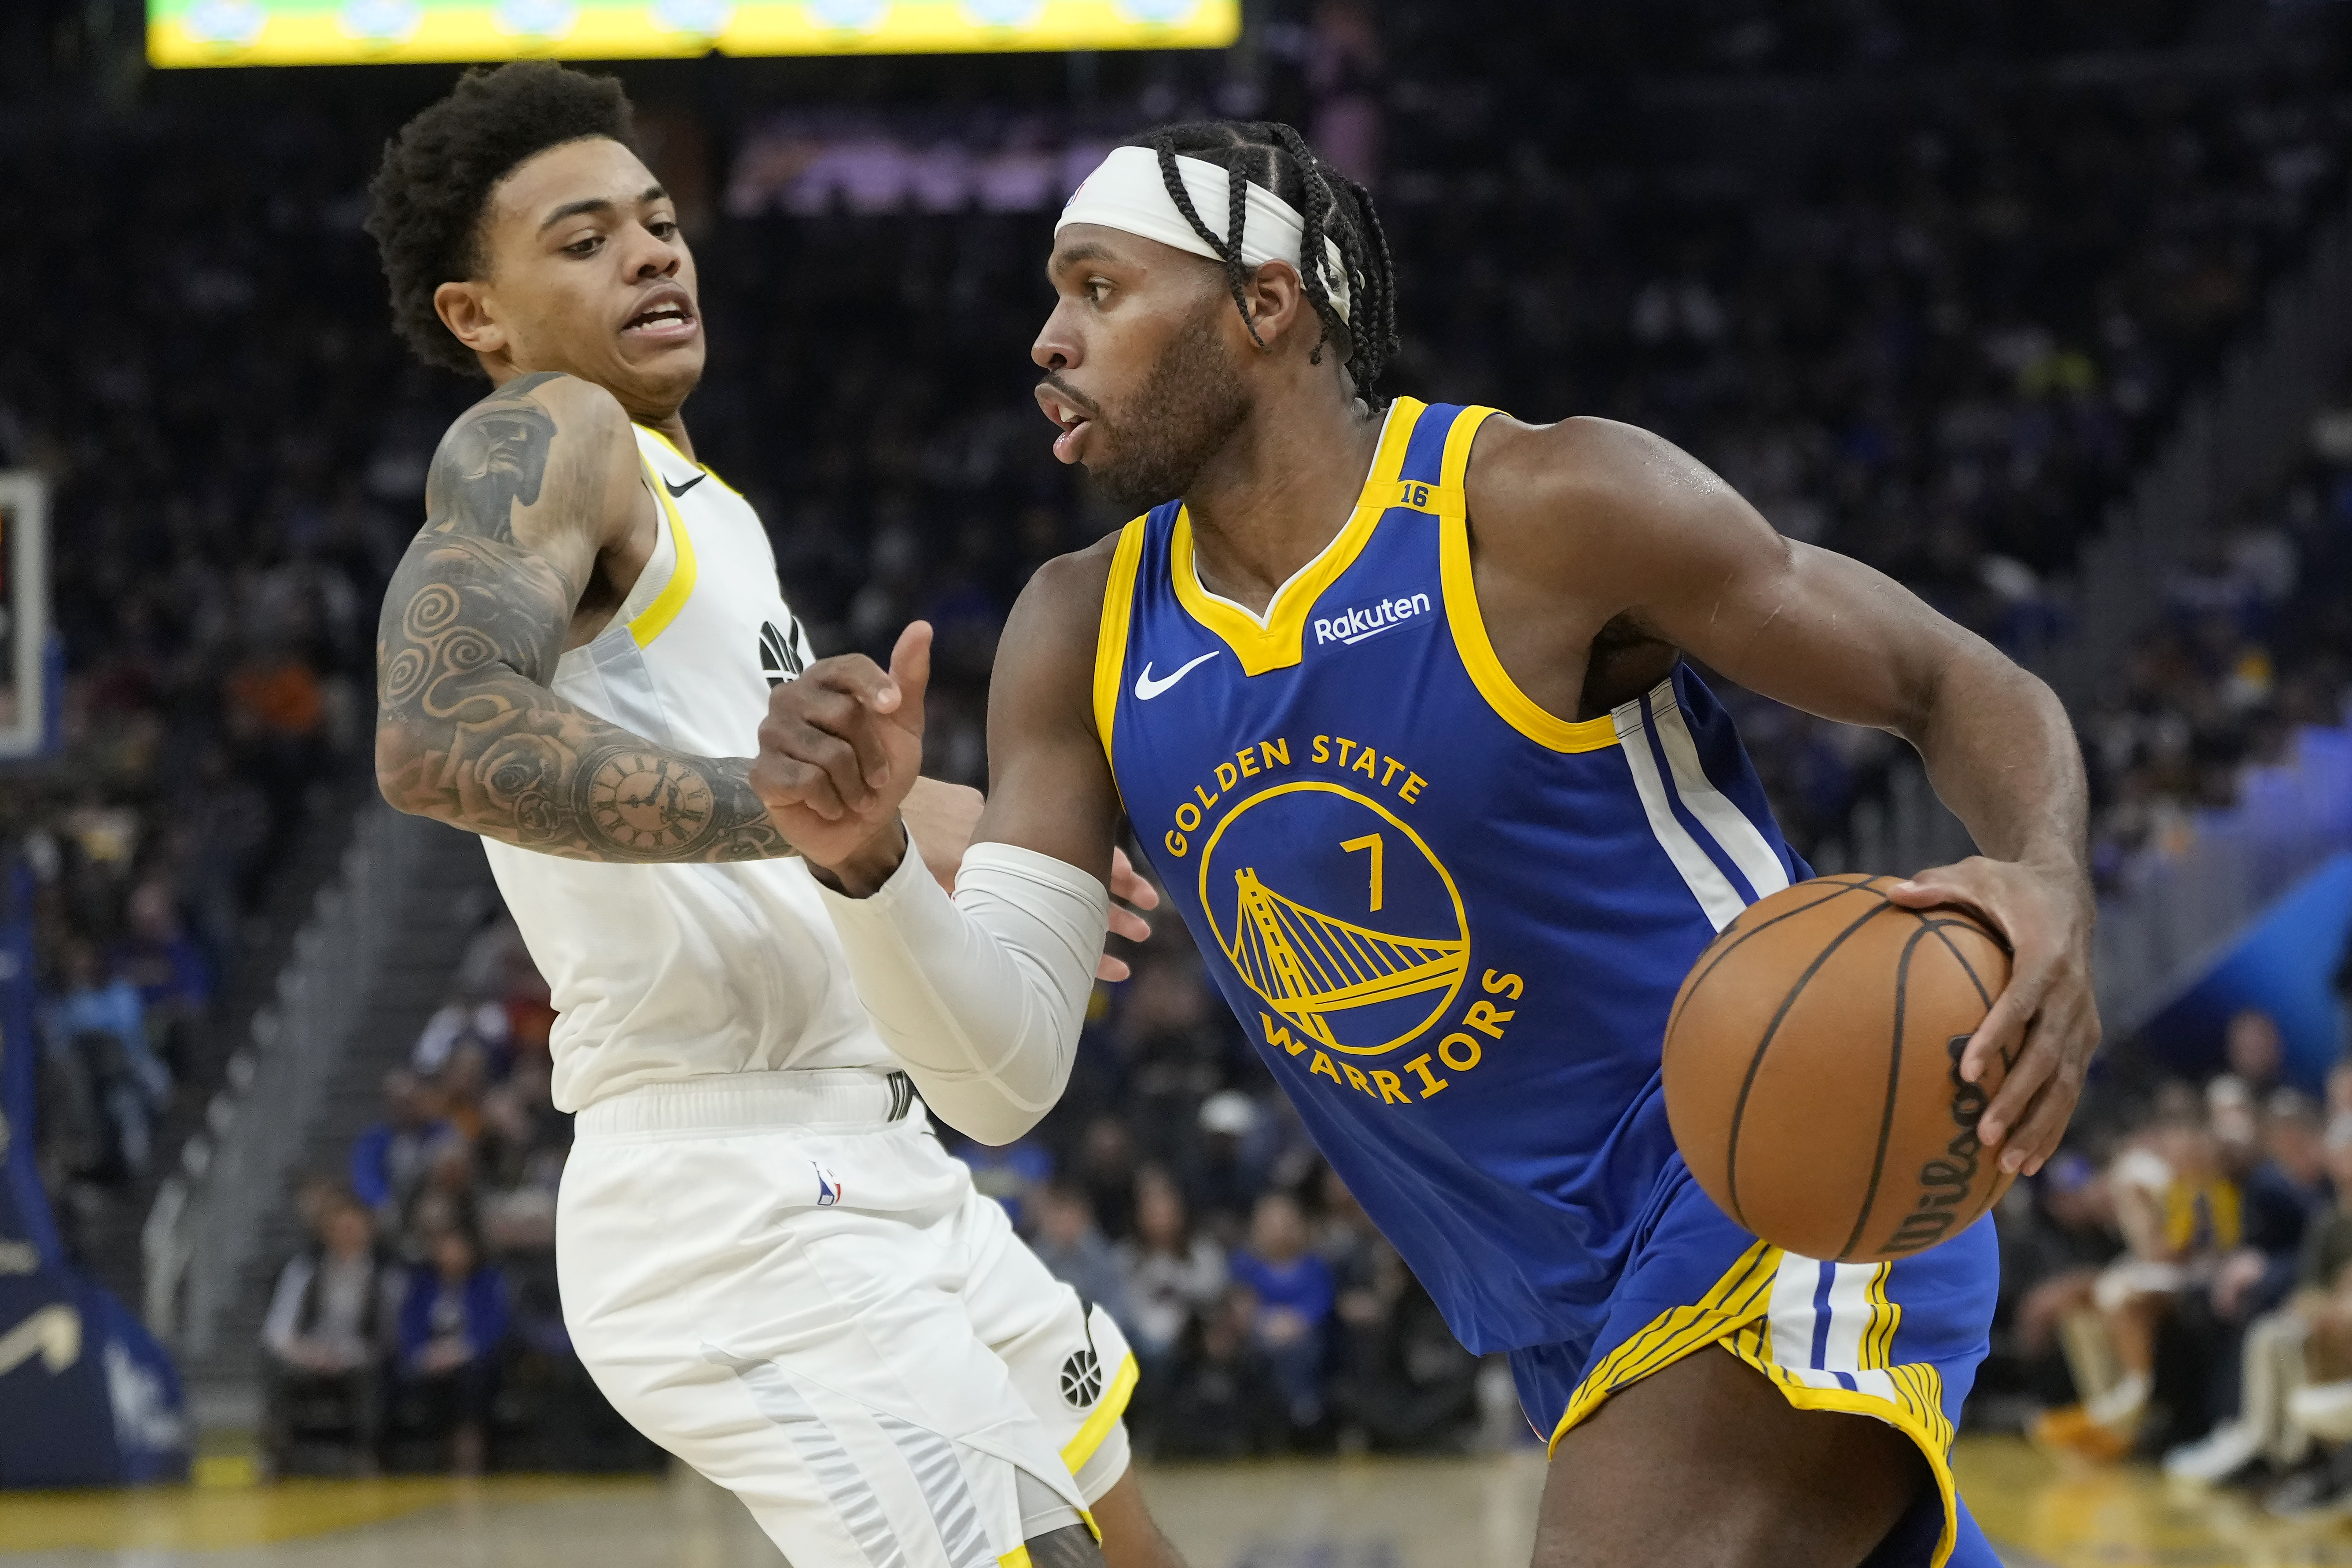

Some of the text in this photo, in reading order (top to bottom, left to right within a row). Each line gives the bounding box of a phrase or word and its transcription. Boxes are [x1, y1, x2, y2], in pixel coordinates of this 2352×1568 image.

[1401, 484, 1429, 508] 16
[1313, 593, 1431, 645] Rakuten
[1165, 734, 1429, 858] GOLDEN STATE
[1340, 832, 1384, 913] 7
[1259, 967, 1524, 1105] WARRIORS
